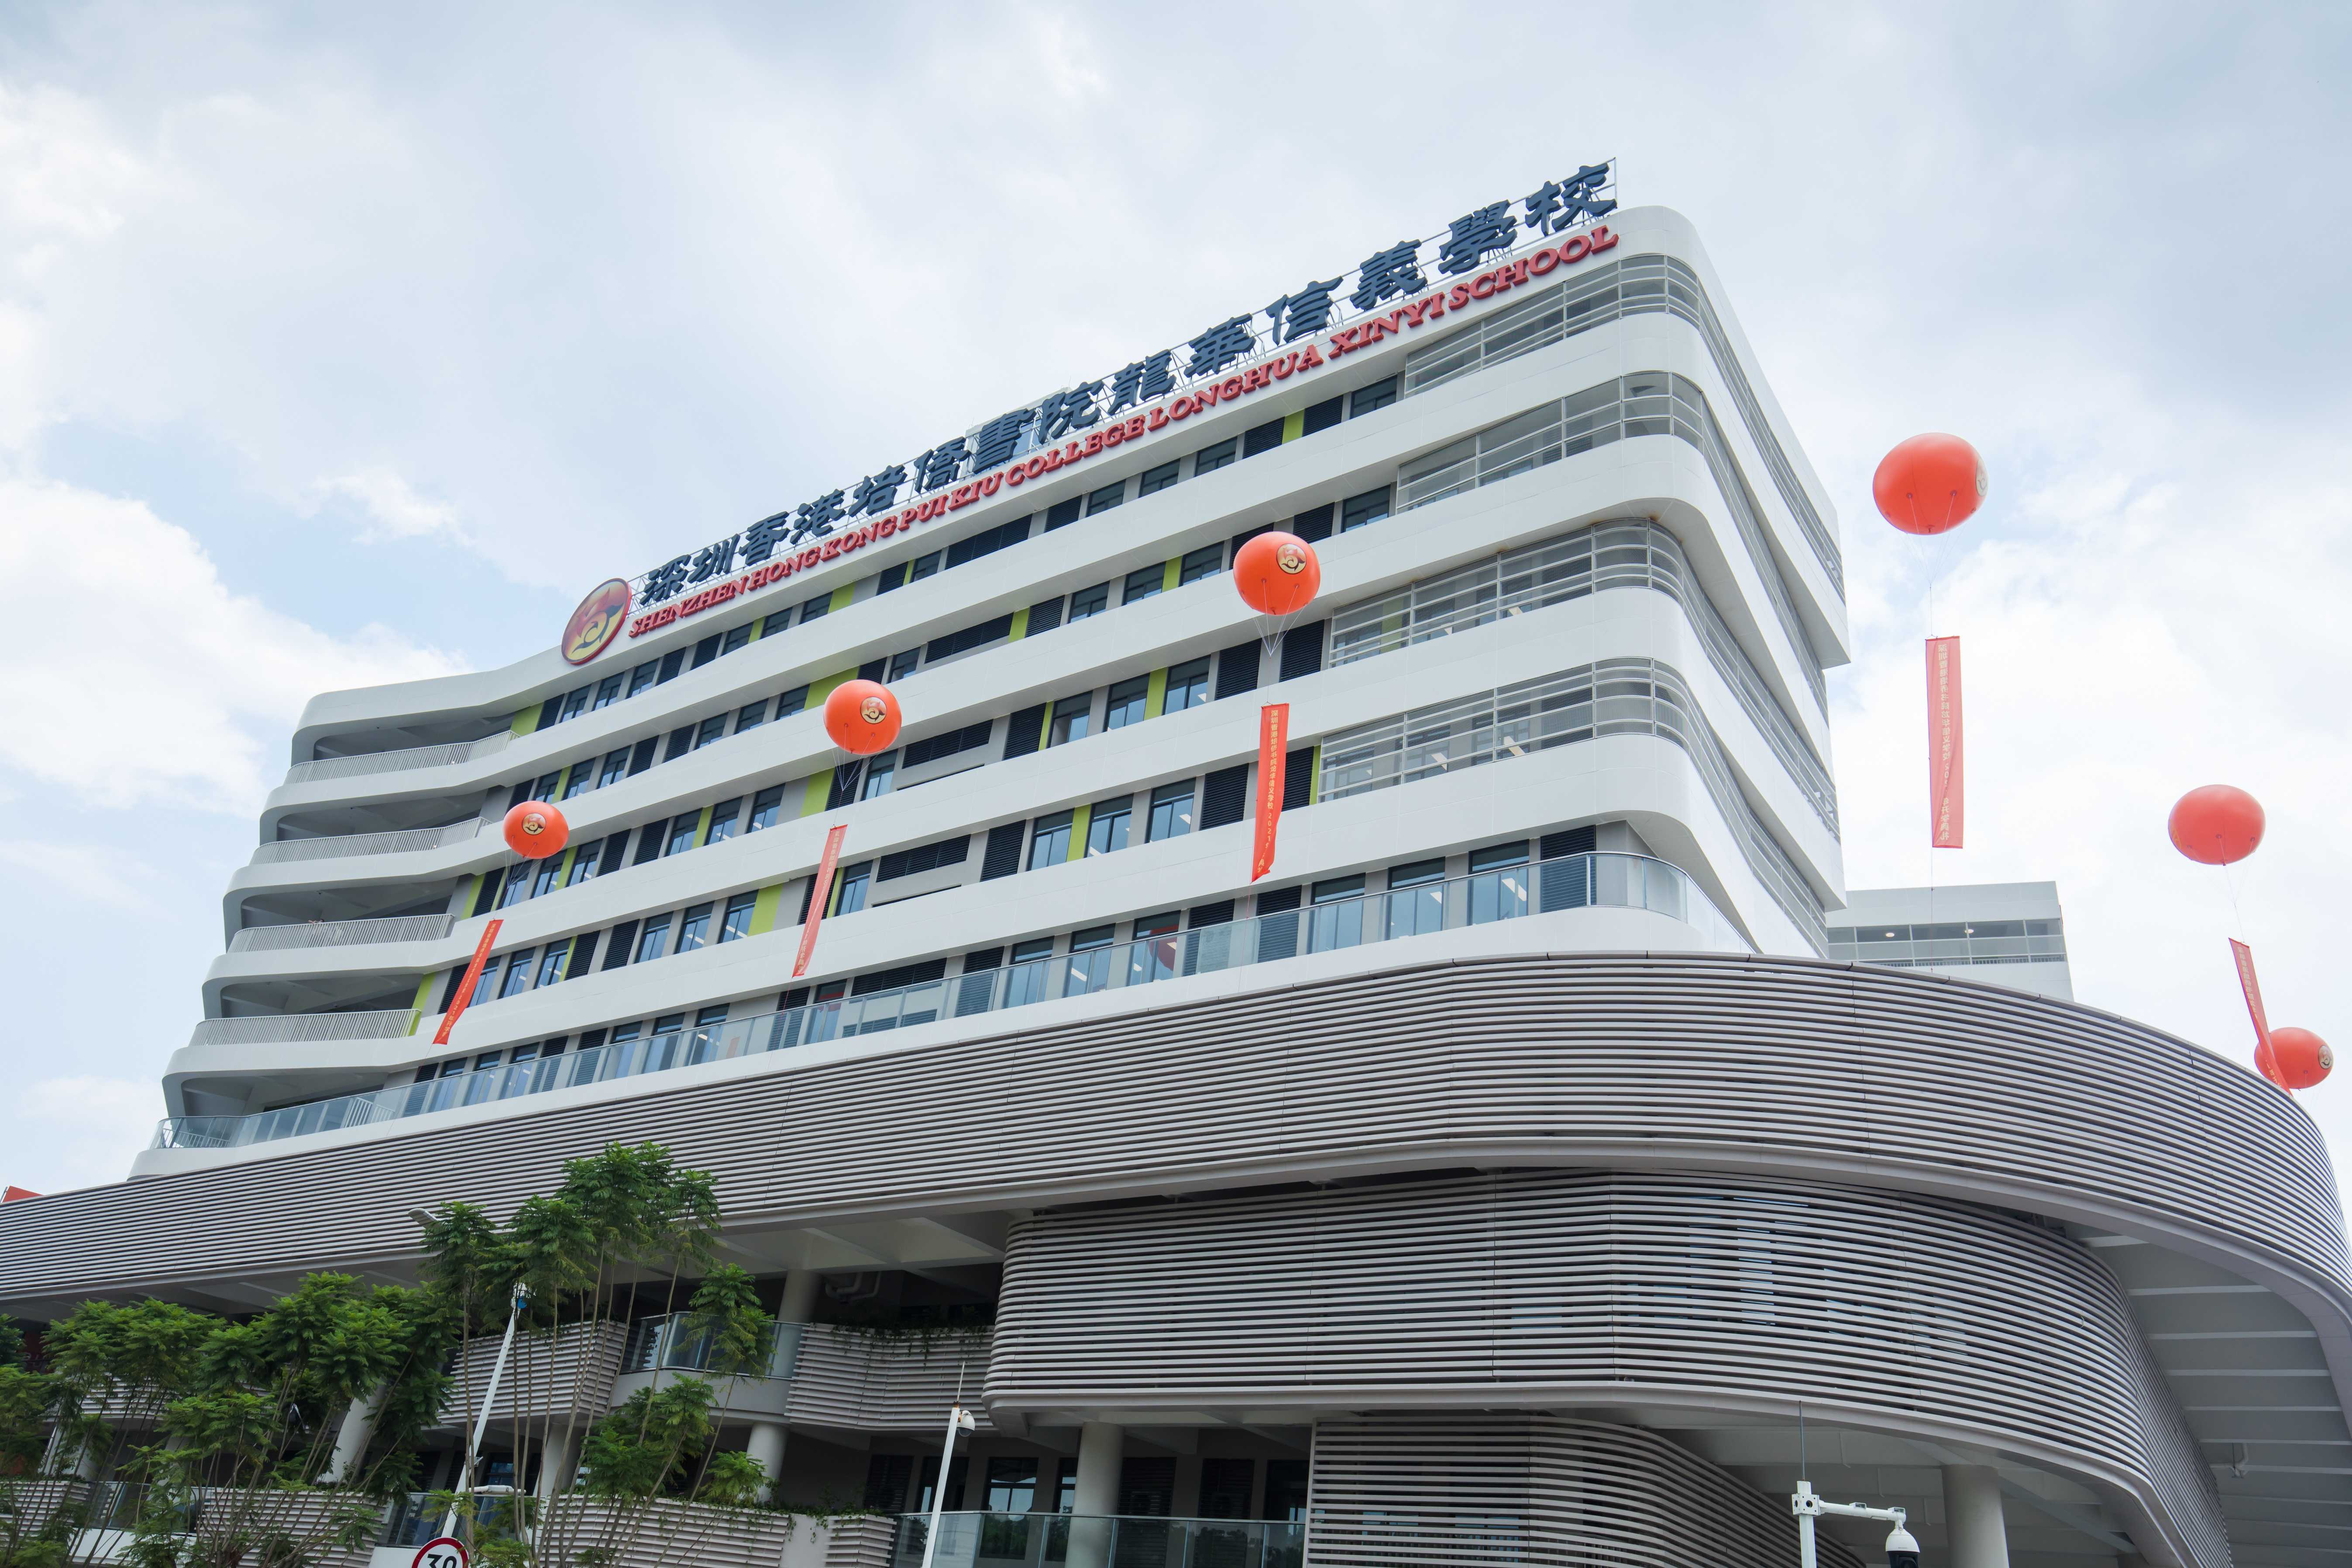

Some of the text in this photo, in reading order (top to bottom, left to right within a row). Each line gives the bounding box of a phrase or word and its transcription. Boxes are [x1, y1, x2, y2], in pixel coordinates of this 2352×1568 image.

[628, 224, 1619, 638] SHENZHEN HONG KONG PUI KIU COLLEGE LONGHUA XINYI SCHOOL
[639, 162, 1617, 605] 深圳香港培僑書院龍華信義學校
[1267, 710, 1278, 810] 深圳香港培侨书院龙华信义学校
